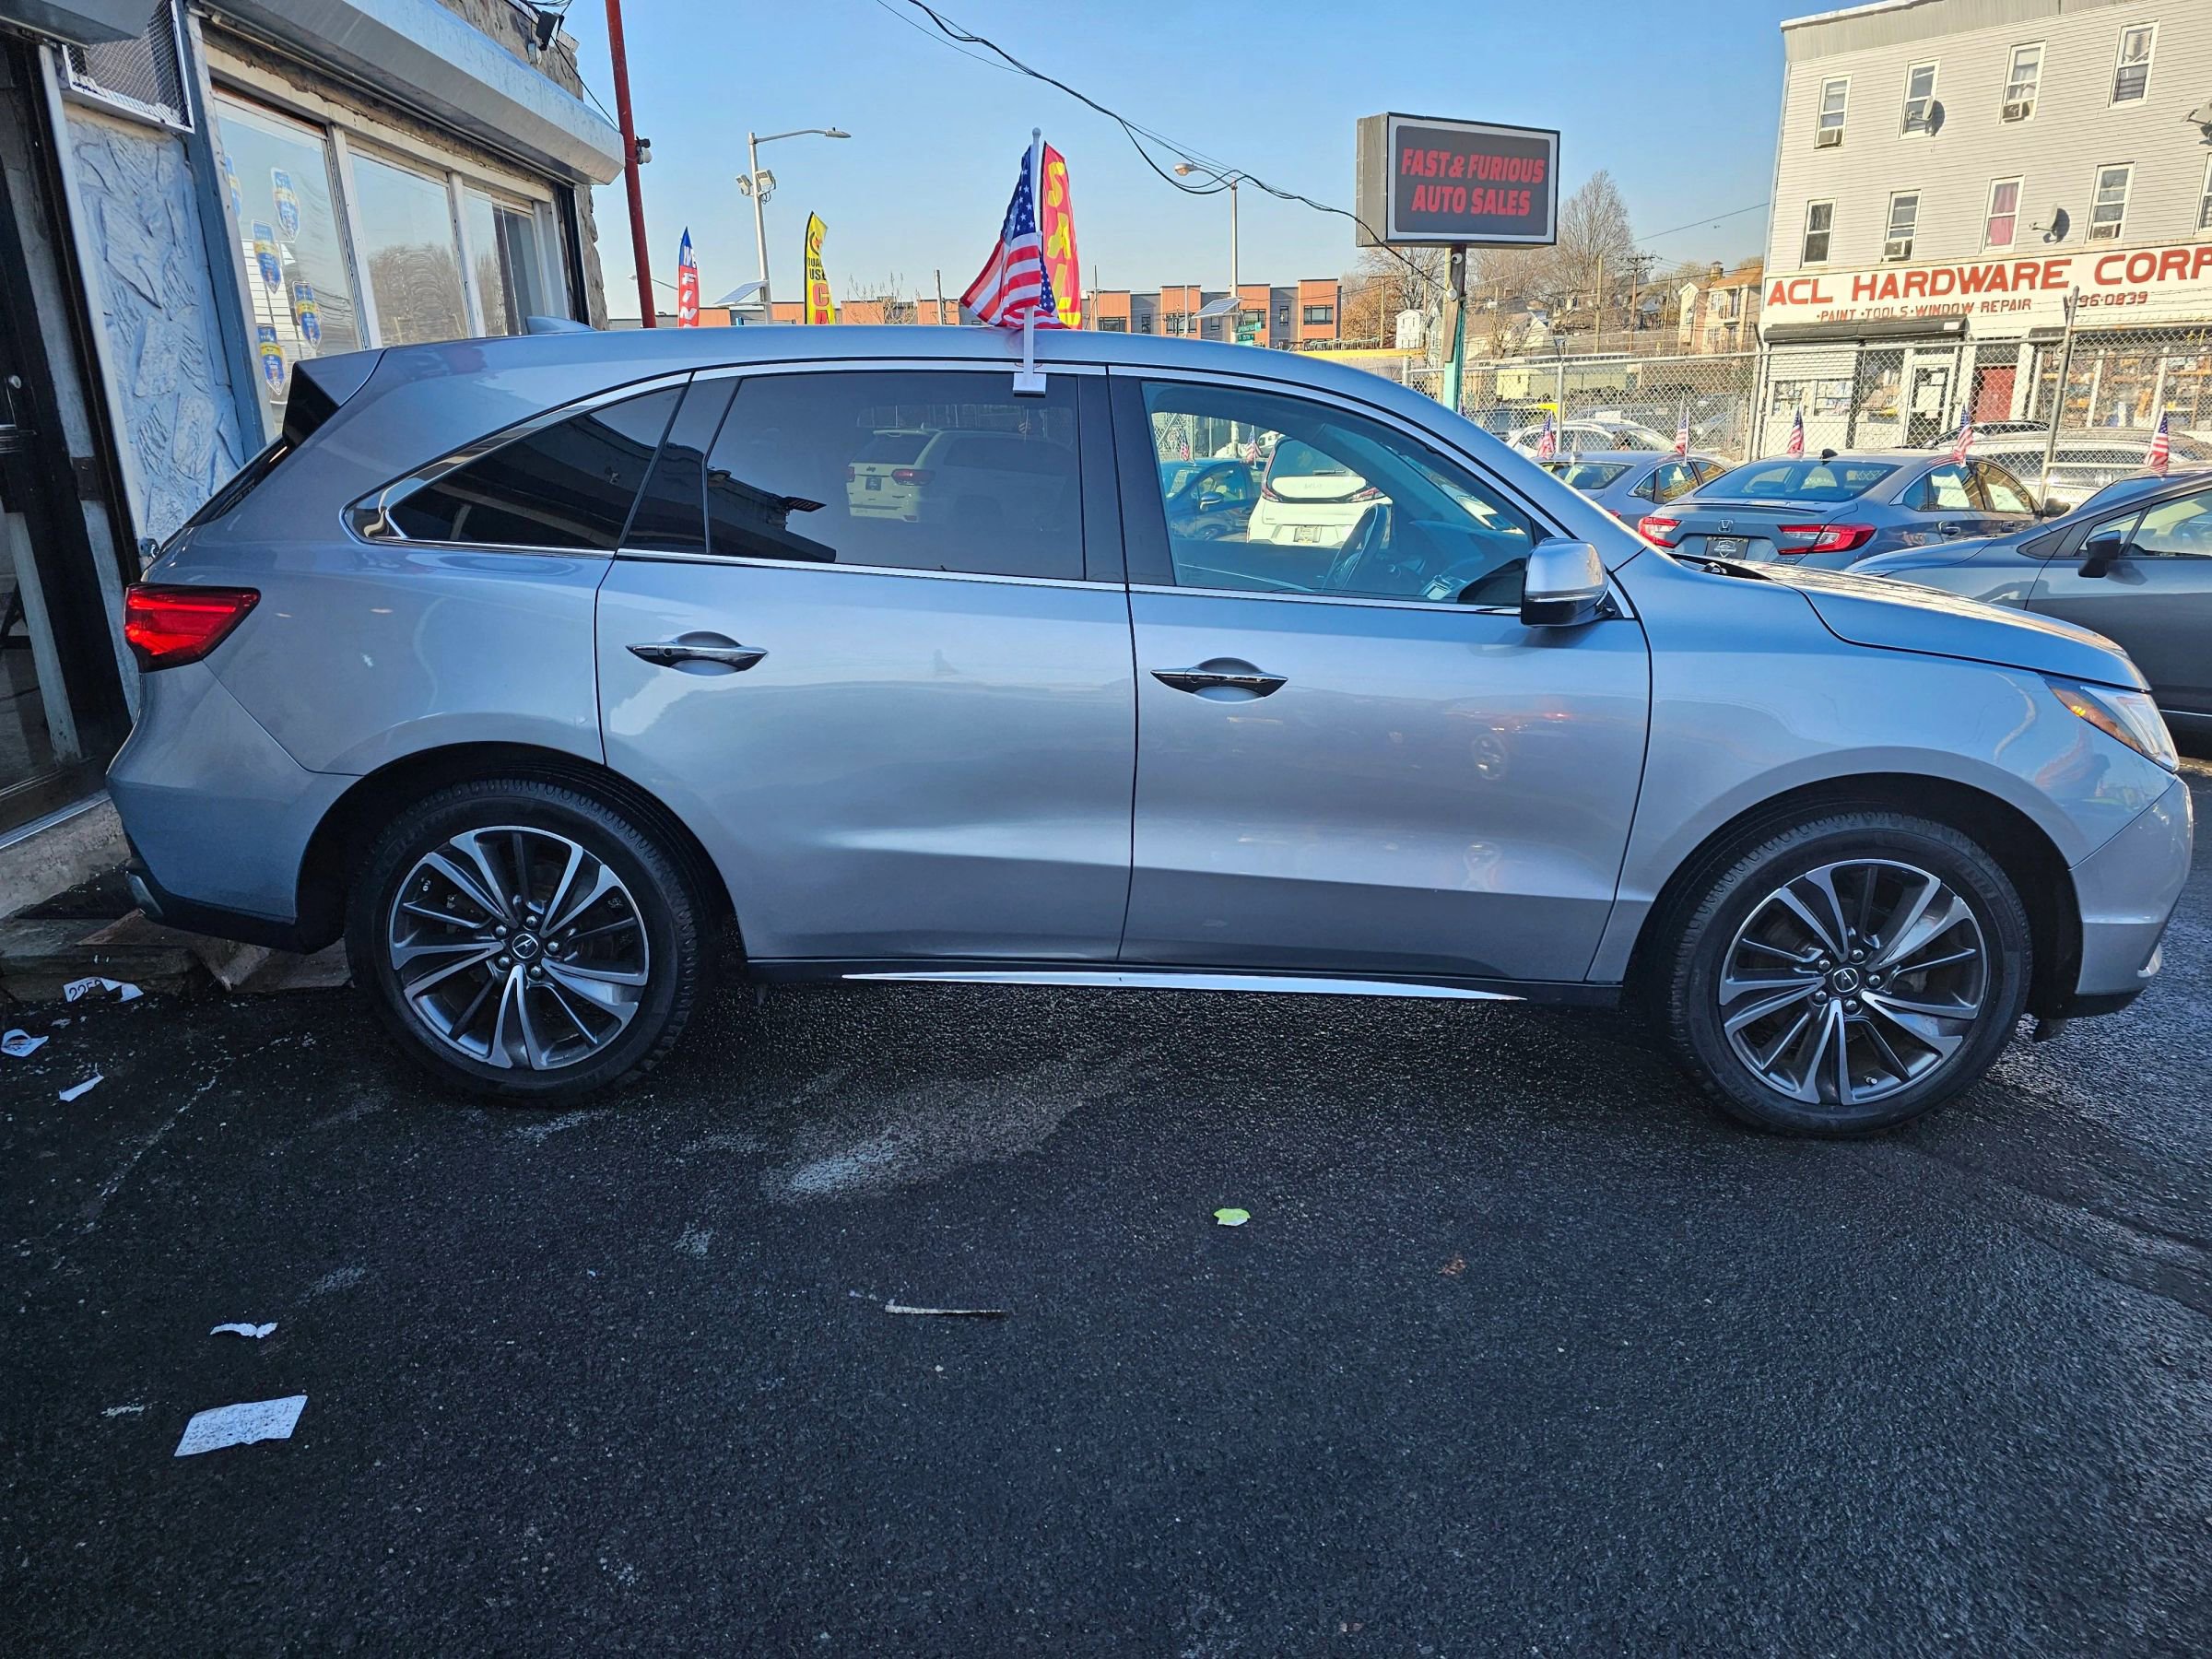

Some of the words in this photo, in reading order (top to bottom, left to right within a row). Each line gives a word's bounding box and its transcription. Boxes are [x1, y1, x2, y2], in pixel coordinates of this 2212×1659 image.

[1401, 147, 1451, 178] FAST
[1448, 154, 1465, 178] &
[1467, 154, 1546, 184] FURIOUS
[1411, 184, 1466, 214] AUTO
[1470, 186, 1532, 217] SALES
[1767, 277, 1833, 306] ACL
[1851, 258, 2073, 301] HARDWARE
[2093, 246, 2212, 286] CORP
[1821, 308, 1856, 323] PAINT
[1865, 305, 1908, 319] TOOLS
[1915, 301, 1975, 316] WINDOW
[1980, 298, 2031, 313] REPAIR
